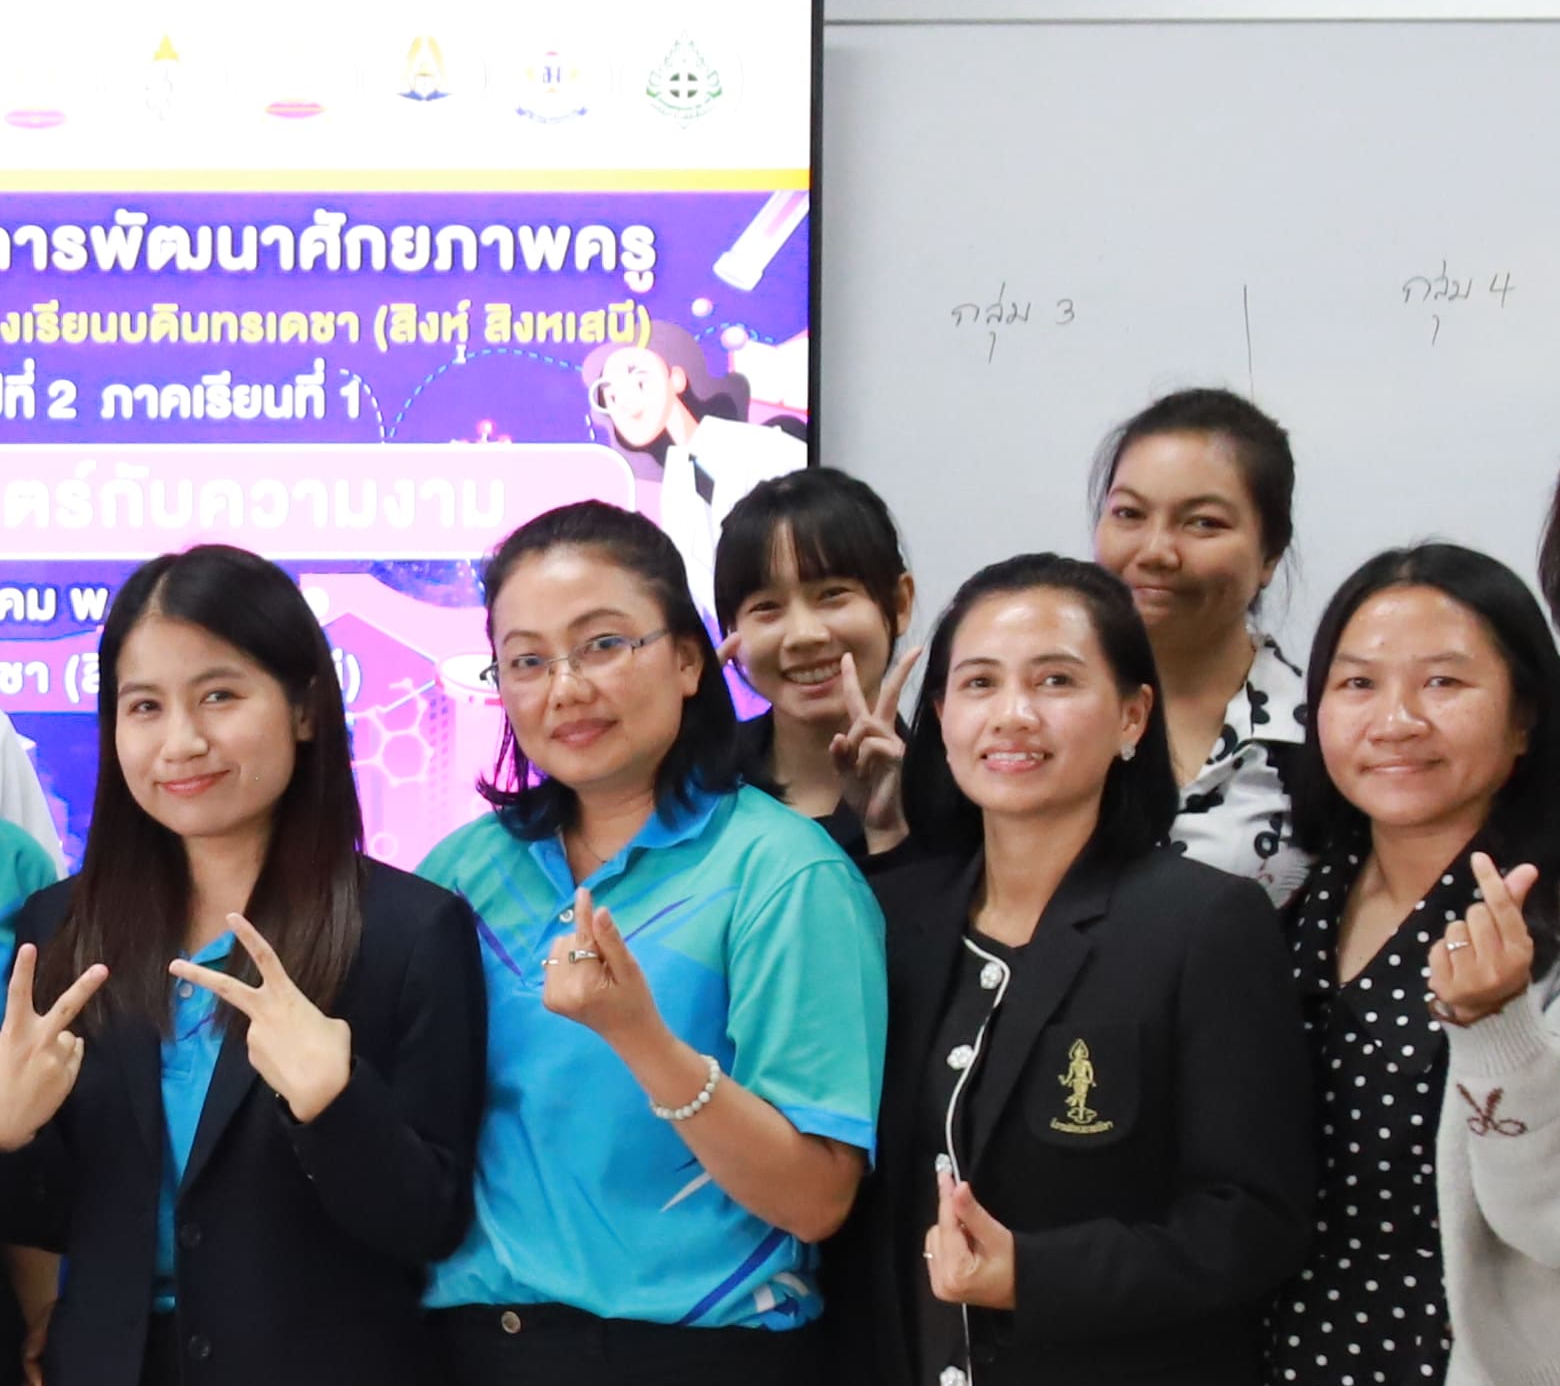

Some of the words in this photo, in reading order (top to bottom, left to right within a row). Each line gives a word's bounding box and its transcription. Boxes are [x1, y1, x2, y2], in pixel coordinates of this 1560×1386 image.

[484, 299, 651, 349] สิงหเสนี)
[951, 280, 1032, 364] กลุ่ม
[1056, 298, 1076, 325] 3
[1402, 258, 1473, 346] กลุ่ม
[1489, 271, 1516, 309] 4
[47, 379, 77, 419] 2
[100, 357, 325, 420] ภาคเรียนที่
[340, 380, 362, 419] 1
